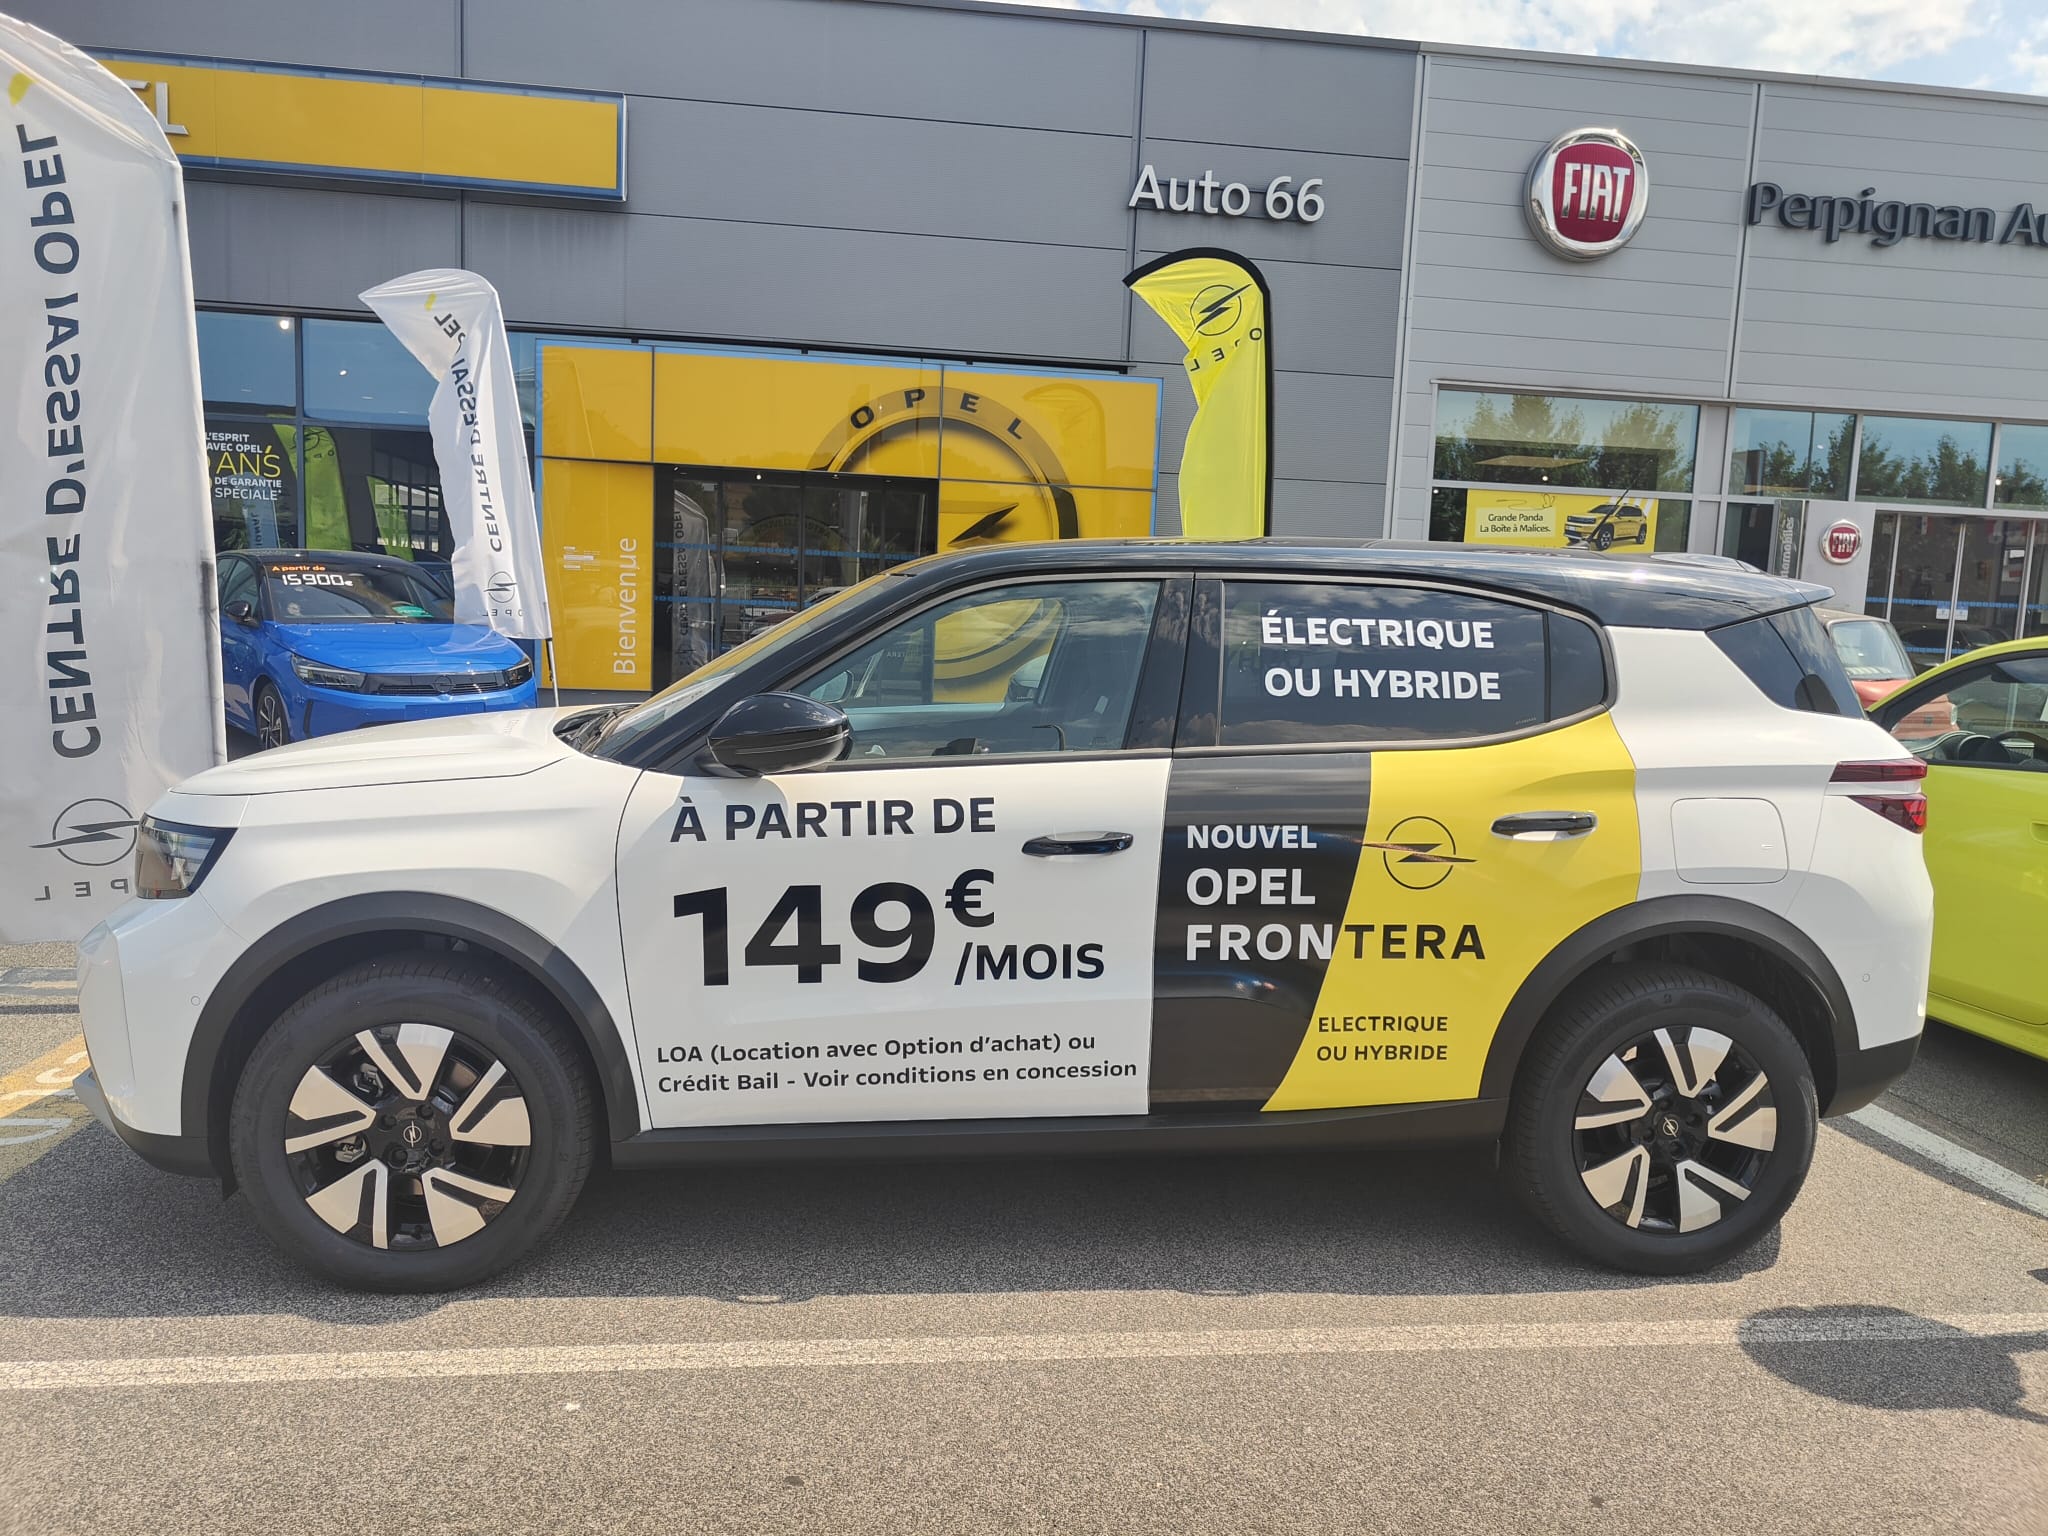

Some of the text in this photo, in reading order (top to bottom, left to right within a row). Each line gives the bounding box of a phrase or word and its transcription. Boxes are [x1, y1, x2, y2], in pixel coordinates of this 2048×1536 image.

[1128, 164, 1325, 222] Auto 66
[1561, 162, 1631, 223] FIAT
[1749, 182, 1997, 248] Perpignan
[850, 388, 1023, 441] OPEL
[206, 442, 263, 454] AVEC OPEL
[214, 476, 282, 488] DE GARANTIE
[1480, 524, 1489, 533] La
[1490, 524, 1512, 533] Boîte
[1512, 524, 1518, 532] à
[1488, 513, 1544, 522] Grande Panda
[1832, 532, 1857, 553] FIAT
[281, 565, 311, 573] partir
[613, 537, 637, 675] Bienvenue
[1261, 609, 1495, 650] ÉLECTRIQUE
[1264, 667, 1501, 700] OU HYBRIDE
[669, 796, 996, 843] À PARTIR DE
[1187, 824, 1317, 849] NOUVEL
[1186, 867, 1316, 906] OPEL
[1186, 922, 1486, 961] FRONTERA
[953, 941, 1105, 986] /MOIS
[1318, 1015, 1448, 1033] ELECTRIQUE
[657, 1046, 703, 1063] LOA
[710, 1041, 820, 1066] (Location
[827, 1043, 878, 1058] avec
[885, 1037, 963, 1060] Option
[1068, 1037, 1095, 1050] ou
[1316, 1044, 1448, 1062] OU HYBRIDE
[658, 1073, 730, 1093] Crédit
[737, 1071, 779, 1090] Bail
[803, 1069, 850, 1088] Voir
[855, 1065, 976, 1086] conditions
[982, 1068, 1009, 1081] en
[1016, 1060, 1137, 1080] concession
